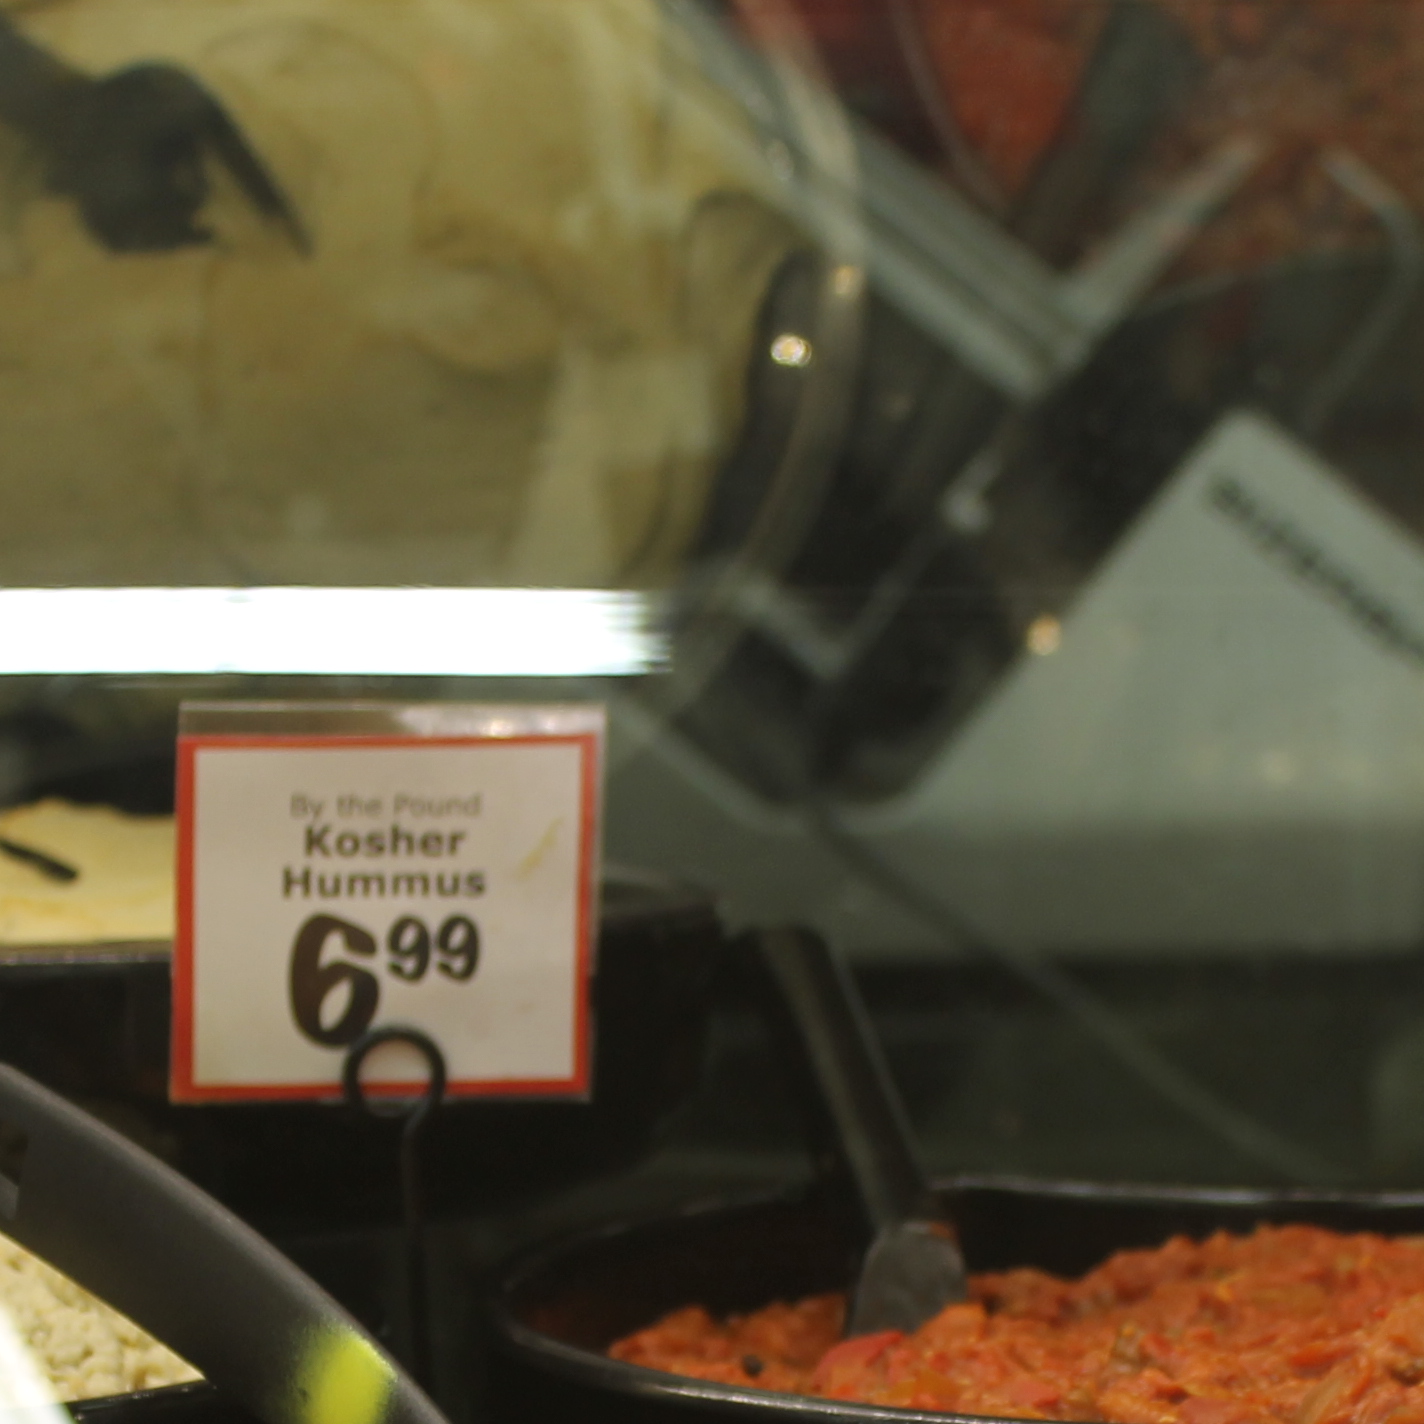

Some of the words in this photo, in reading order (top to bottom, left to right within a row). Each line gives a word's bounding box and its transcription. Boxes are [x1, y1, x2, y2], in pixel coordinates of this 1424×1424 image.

[291, 793, 323, 821] By
[337, 793, 382, 818] the
[394, 793, 482, 818] Pound
[304, 824, 466, 858] Kosher
[282, 867, 486, 899] Hummus
